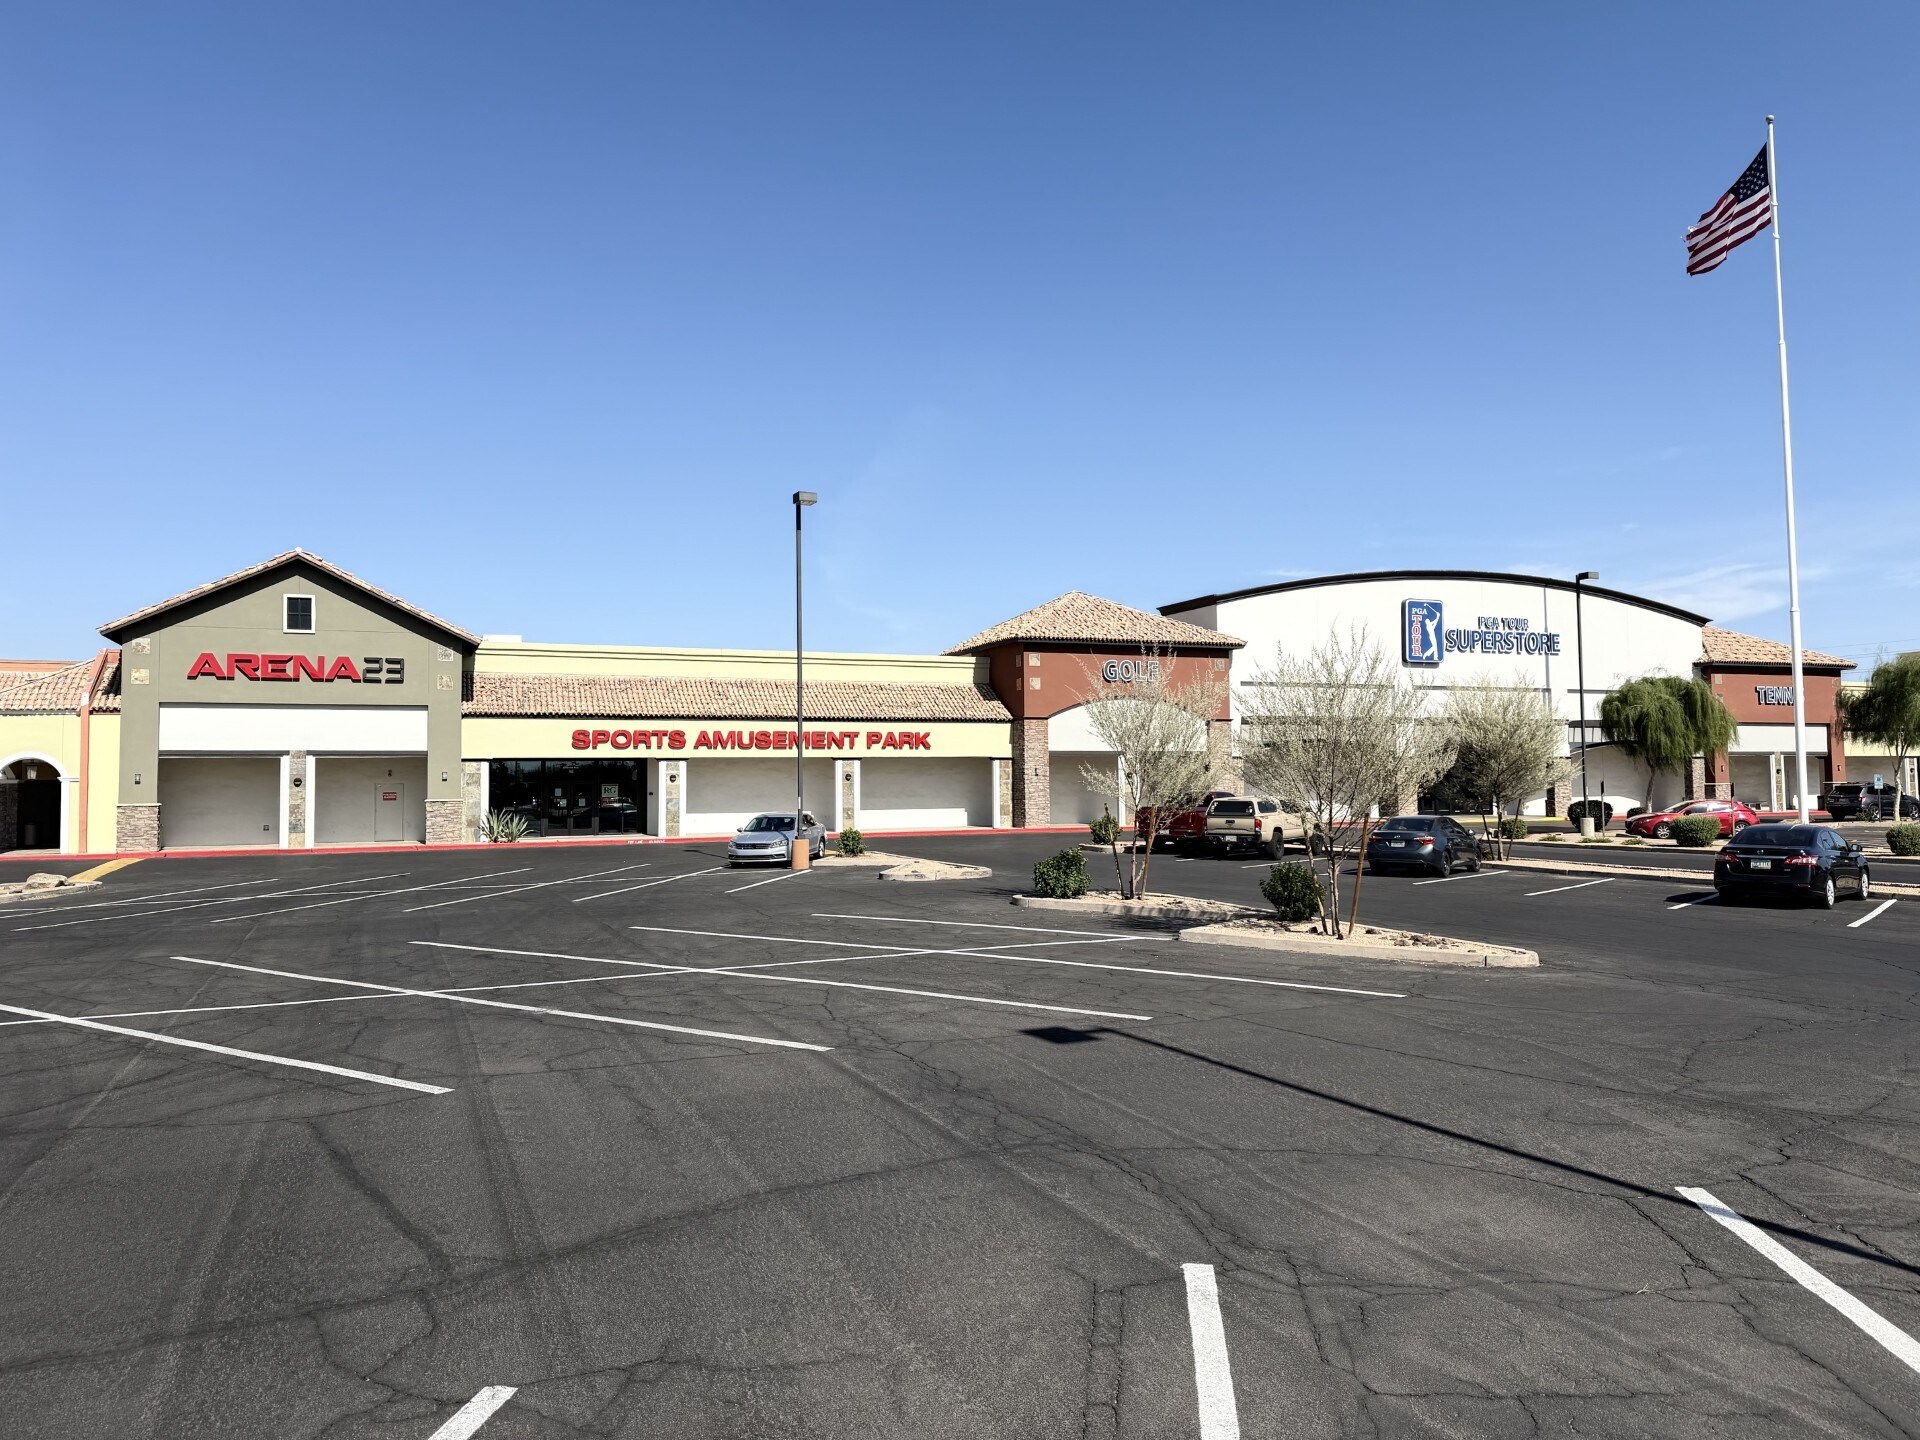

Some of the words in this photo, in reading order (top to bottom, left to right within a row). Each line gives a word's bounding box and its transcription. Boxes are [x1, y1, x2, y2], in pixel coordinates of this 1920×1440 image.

[1411, 607, 1428, 615] PGA
[1478, 616, 1500, 630] PGA
[1502, 617, 1529, 632] TOUR
[1411, 615, 1422, 657] TOUR
[1445, 628, 1561, 656] SUPERSTORE
[1101, 659, 1159, 682] GOLF
[1755, 685, 1804, 705] TENN
[571, 729, 687, 750] SPORTS
[693, 730, 860, 750] AMUSEMENT
[866, 731, 932, 750] PARK
